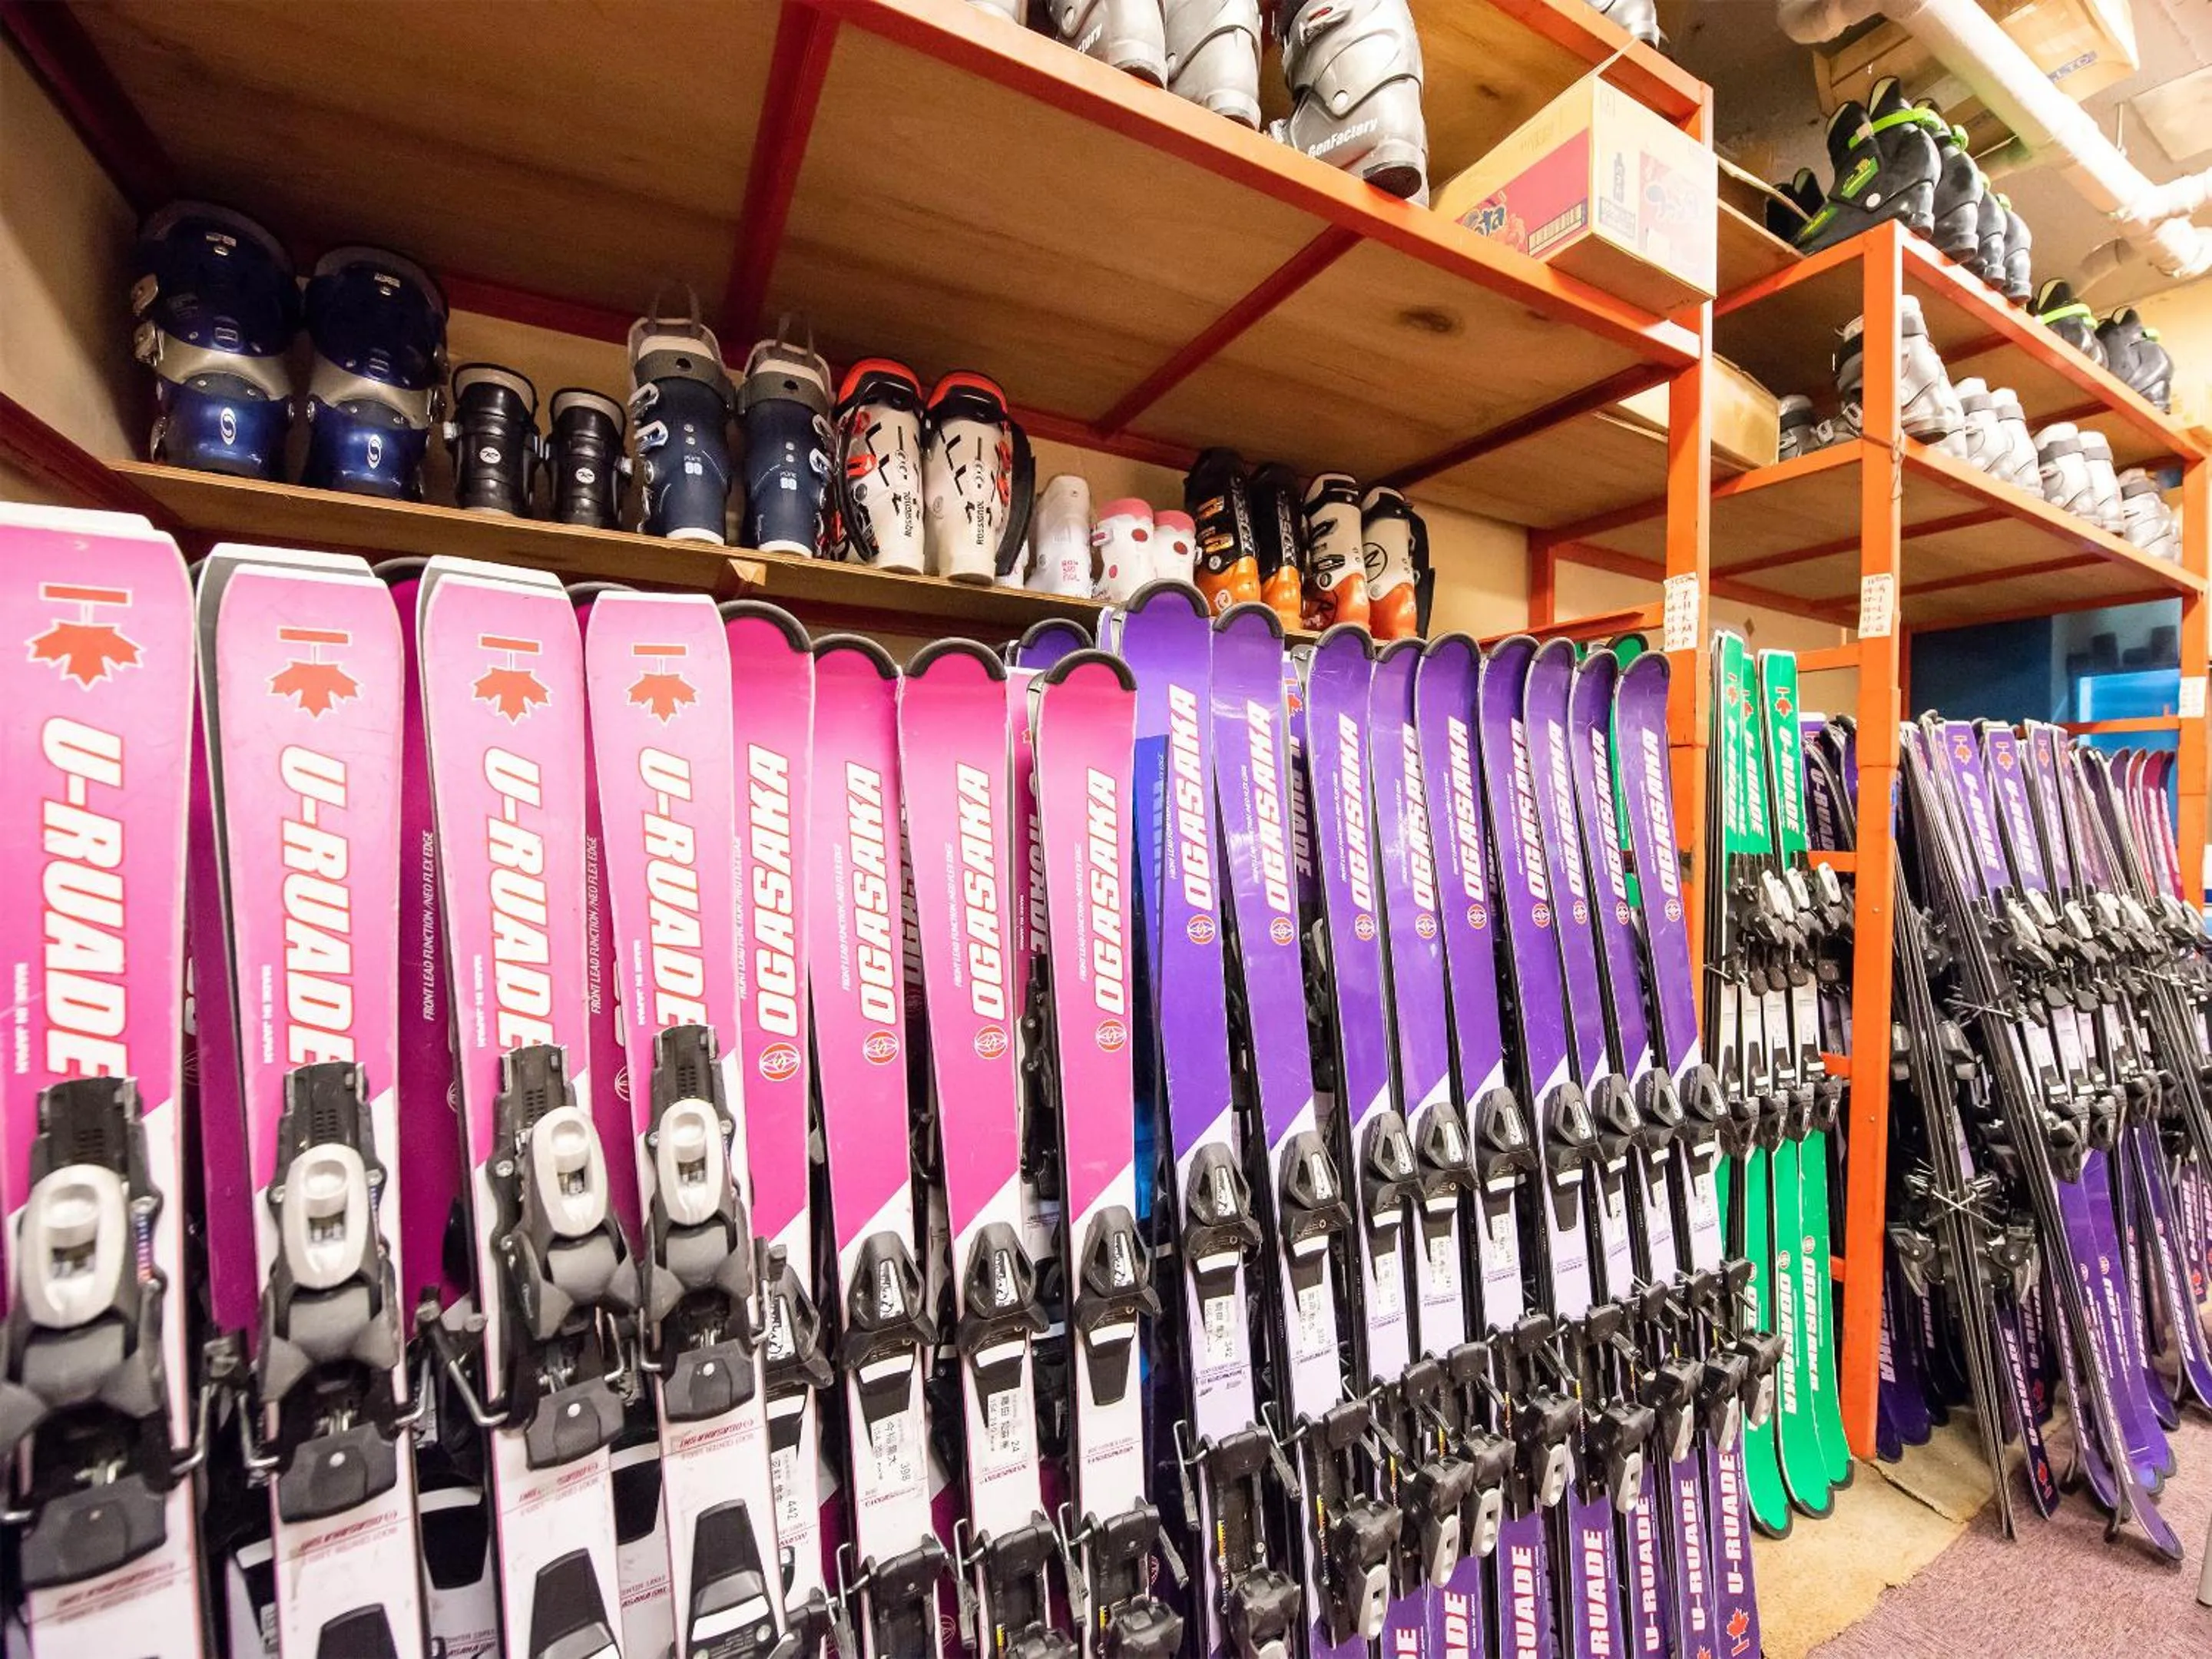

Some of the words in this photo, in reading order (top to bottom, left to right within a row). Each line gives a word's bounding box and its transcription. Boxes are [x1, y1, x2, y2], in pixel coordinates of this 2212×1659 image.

[1308, 118, 1378, 157] GenFactory
[976, 500, 985, 545] ROSSIGNOL
[422, 830, 433, 857] EDGE
[587, 836, 597, 859] EDGE
[1168, 684, 1214, 911] OGASAKA
[1247, 699, 1291, 913] OGASAKA
[1339, 712, 1372, 912] OGASAKA
[1449, 715, 1485, 902] OGASAKA
[1548, 719, 1584, 898] OGASAKA
[1591, 727, 1628, 902] OGASAKA
[1641, 727, 1679, 898] OGASAKA
[1779, 725, 1800, 834] U-RUADE
[41, 716, 129, 1078] U-RUADE
[278, 744, 356, 1066] U-RUADE
[423, 858, 434, 882] FLEX
[423, 910, 435, 960] FUNCTION
[482, 745, 557, 1050] U-RUADE
[588, 859, 598, 882] FLEX
[589, 910, 601, 960] FUNCTION
[637, 746, 710, 1028] U-RUADE
[747, 743, 798, 1038] OGASAKA
[845, 760, 896, 1025] OGASAKA
[955, 760, 1005, 1021] OGASAKA
[1087, 767, 1124, 1015] OGASAKA
[423, 960, 435, 988] LEAD
[423, 986, 435, 1021] FRONT
[590, 960, 601, 986] LEAD
[591, 985, 601, 1014] FRONT
[1802, 1256, 1820, 1391] OGASAKA
[1636, 1496, 1659, 1651] U-RUADE
[1681, 1479, 1706, 1631] U-RUADE
[1719, 1453, 1744, 1594] U-RUADE
